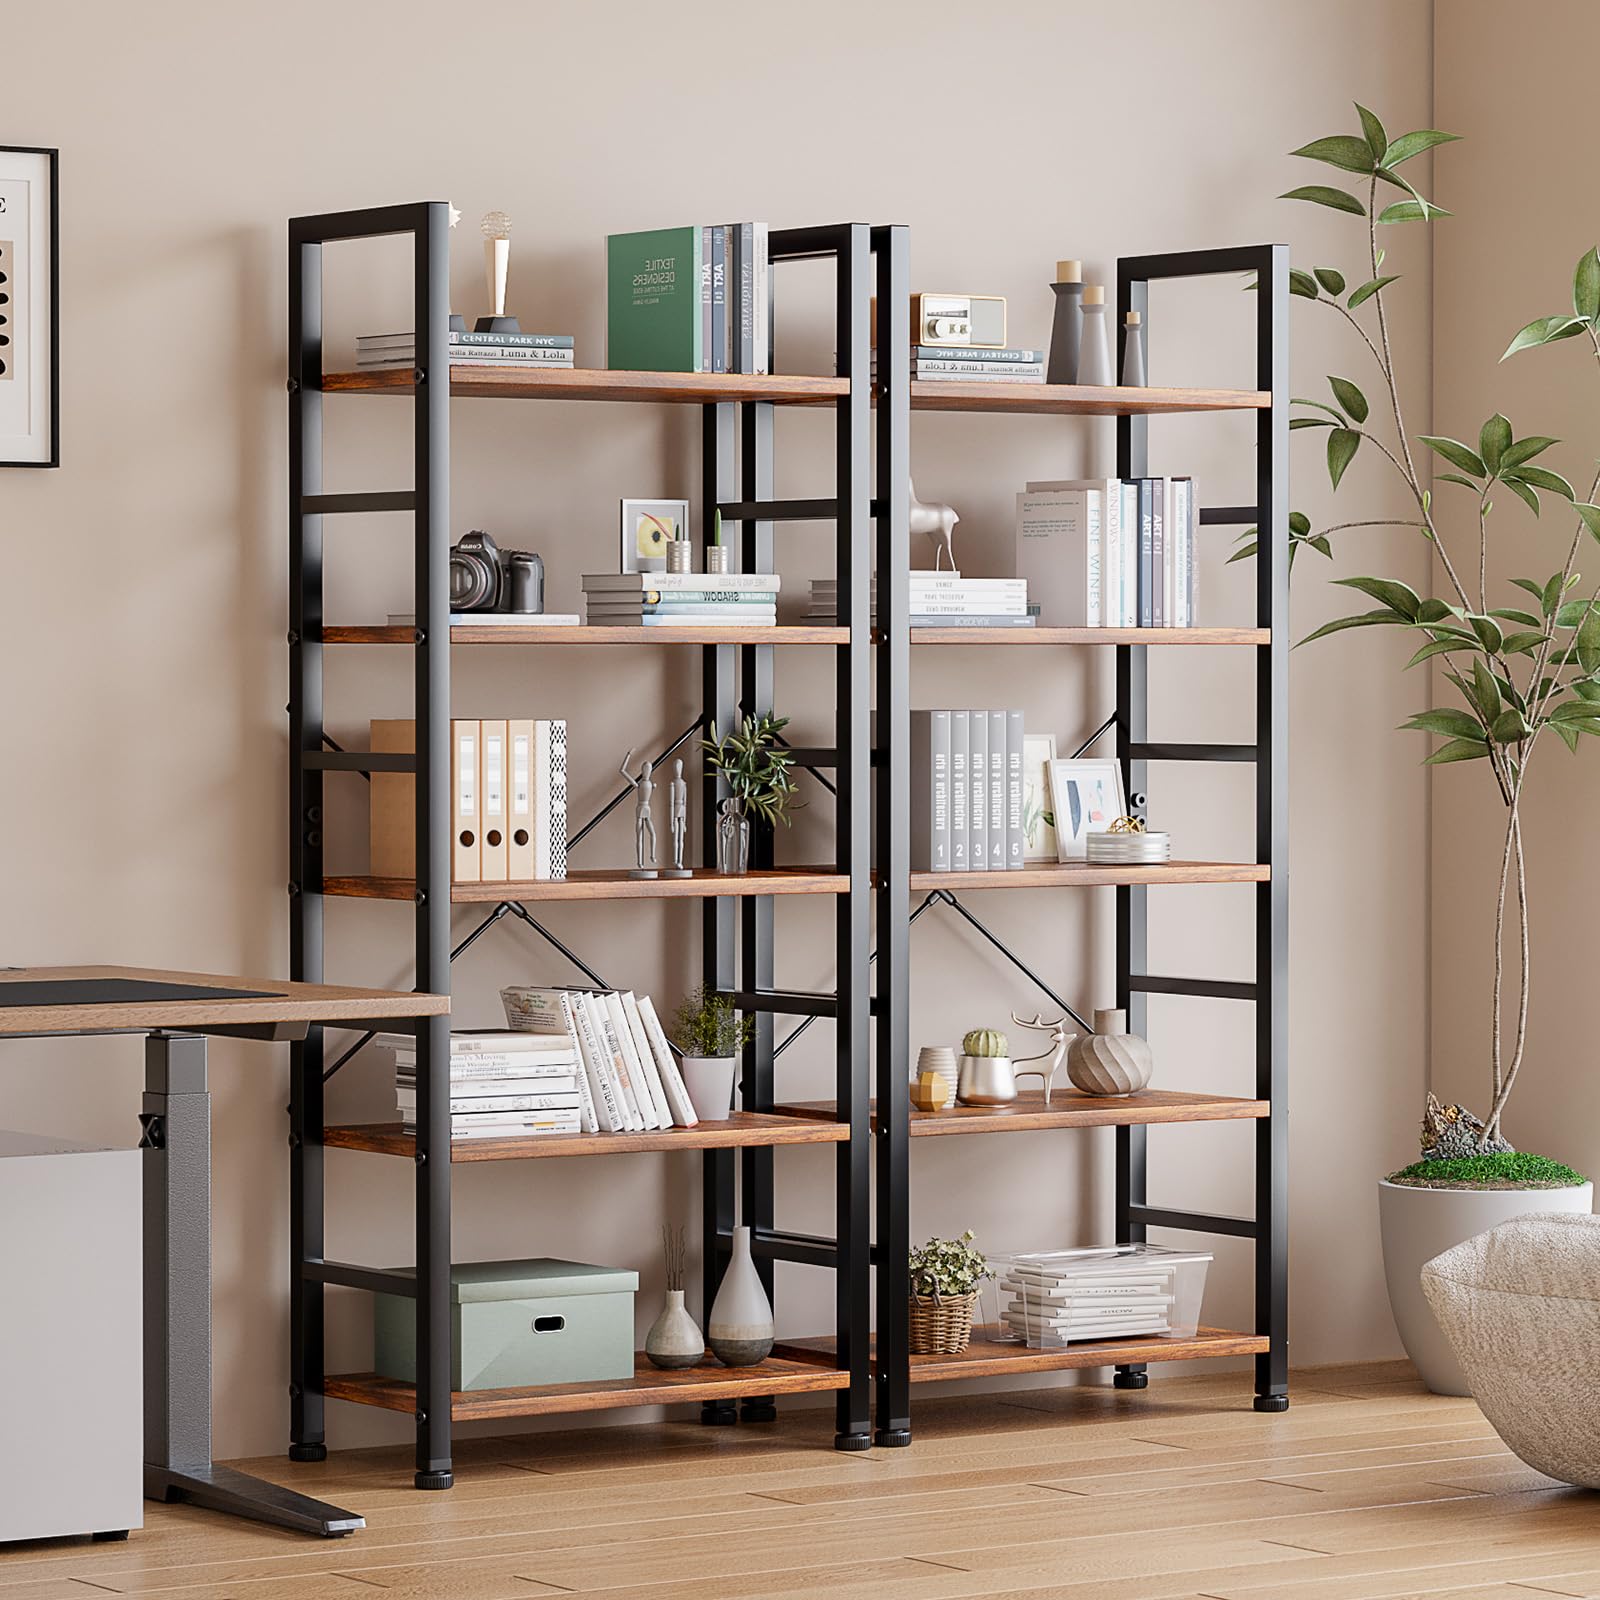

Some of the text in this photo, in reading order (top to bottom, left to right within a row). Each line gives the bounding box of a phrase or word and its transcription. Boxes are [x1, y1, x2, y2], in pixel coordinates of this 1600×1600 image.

[462, 335, 506, 344] CENTRAL
[509, 336, 533, 345] PARK
[500, 349, 527, 358] Luna
[530, 350, 539, 358] &
[542, 350, 566, 359] Lola
[1110, 484, 1120, 545] WINDOWS
[1143, 513, 1152, 539] ART
[1153, 513, 1162, 539] ART
[1090, 509, 1100, 609] FINE WINES
[936, 782, 946, 830] architecture
[954, 782, 966, 830] architecture
[973, 781, 984, 829] architecture
[992, 781, 1003, 829] architecture
[1010, 781, 1021, 829] architecture
[938, 844, 943, 857] 1
[956, 844, 963, 857] 2
[974, 844, 982, 857] 3
[993, 843, 1000, 856] 4
[1012, 843, 1019, 856] 5
[572, 994, 584, 1010] FIND
[581, 1023, 593, 1040] LOVE
[600, 1082, 614, 1104] AFTER
